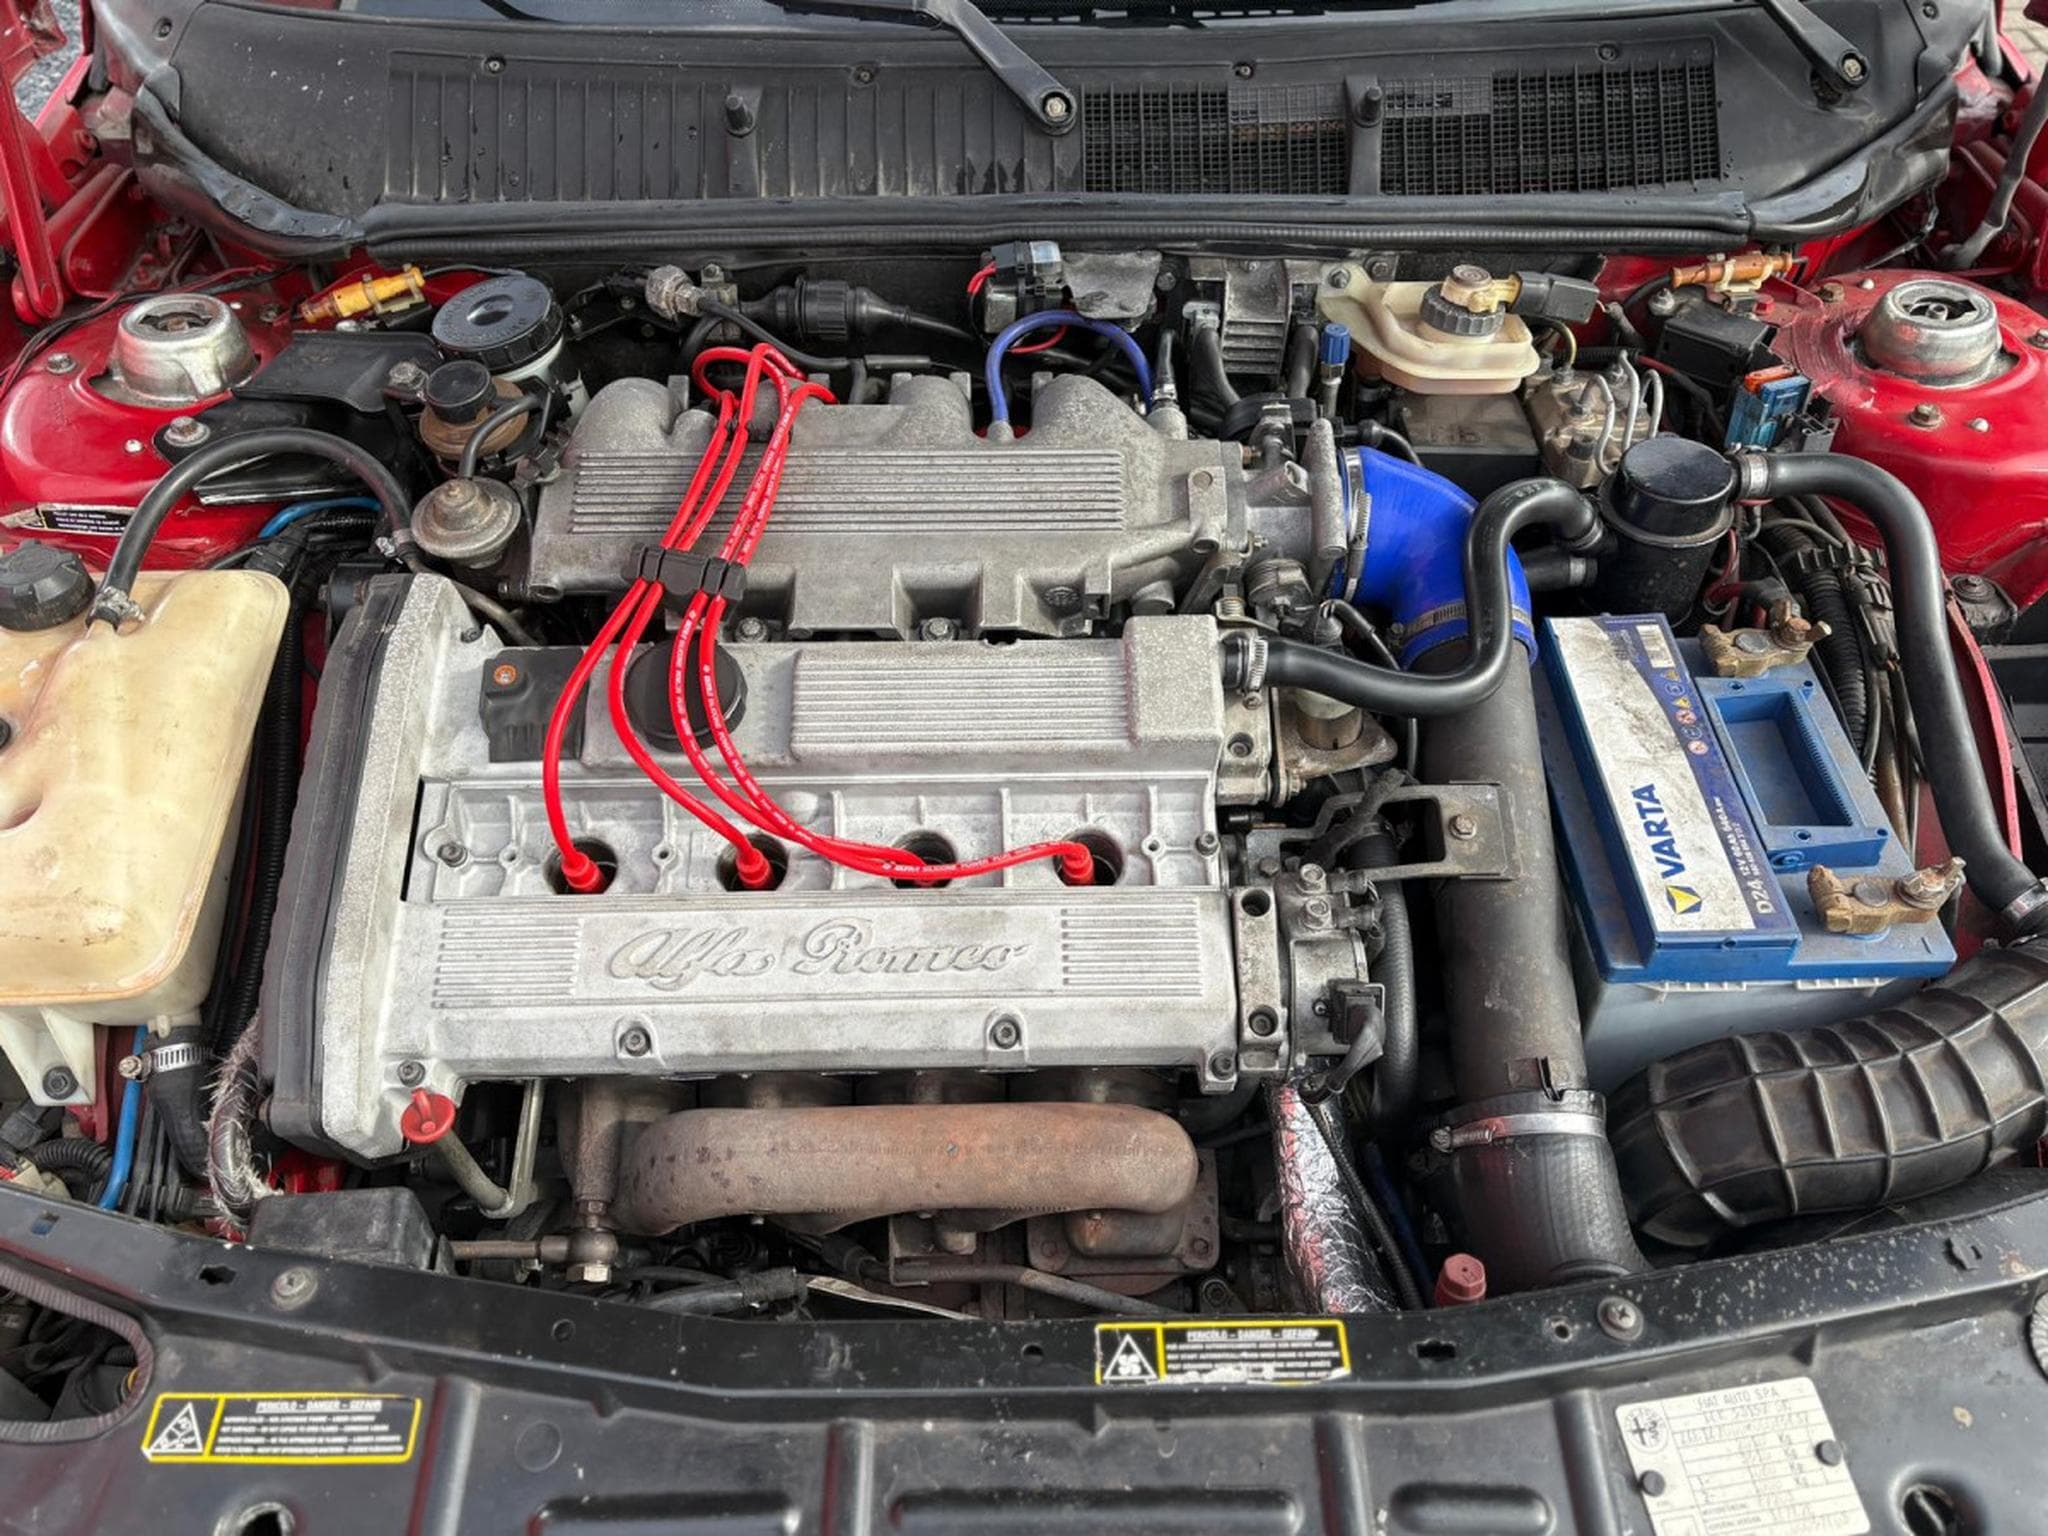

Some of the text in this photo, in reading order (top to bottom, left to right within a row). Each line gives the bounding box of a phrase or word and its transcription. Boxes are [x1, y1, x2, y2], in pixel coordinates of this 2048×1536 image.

[1632, 784, 1686, 879] VARTA
[1747, 879, 1777, 914] D24
[608, 916, 1030, 991] Alfa Romeo
[305, 1400, 341, 1413] DANGER
